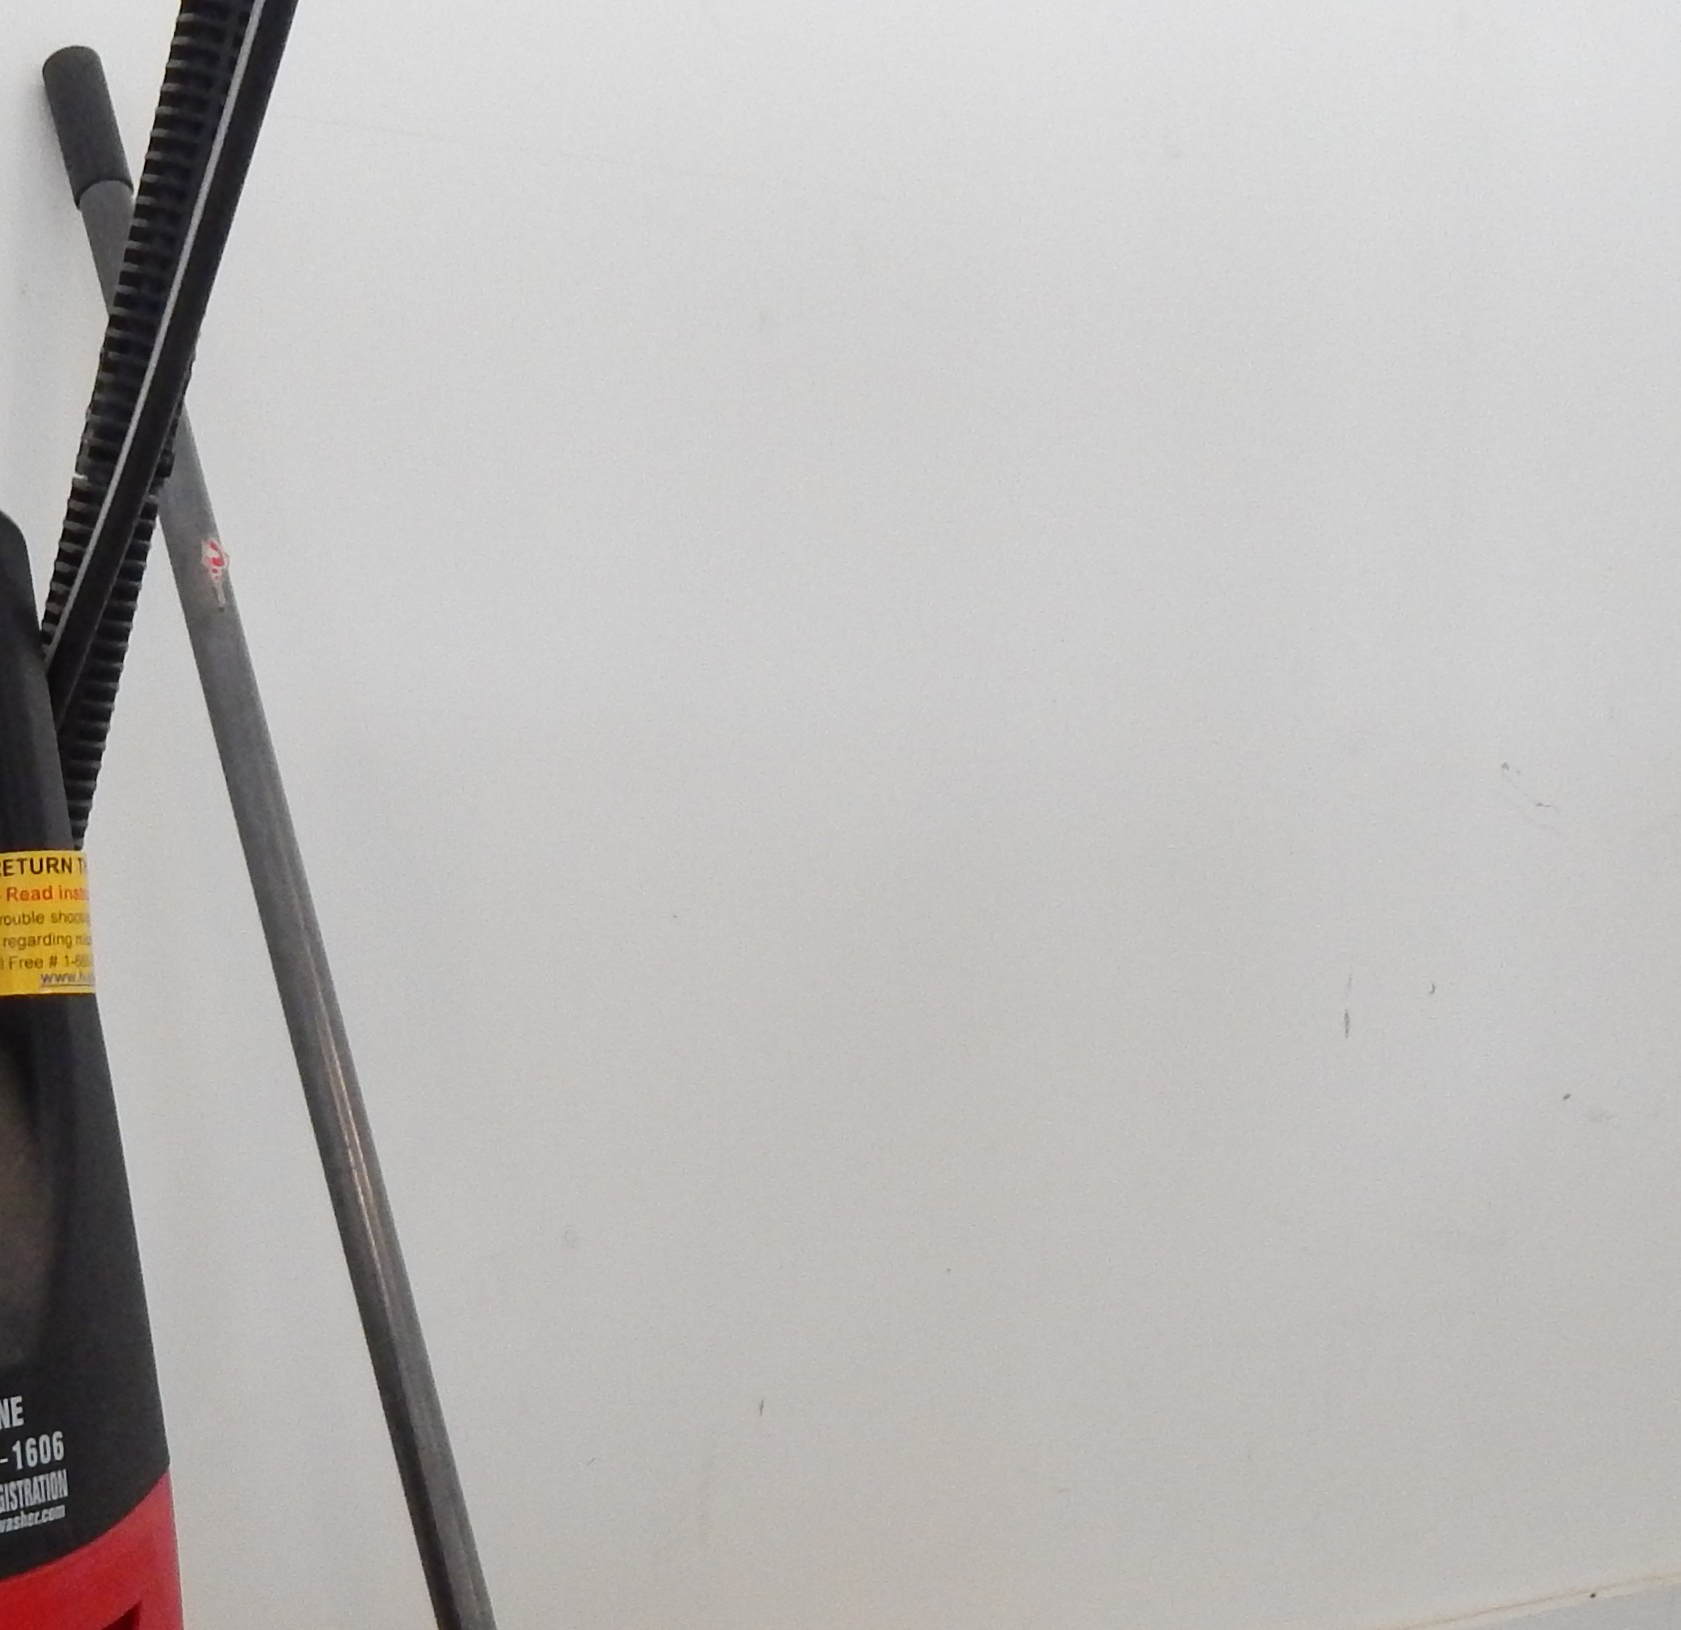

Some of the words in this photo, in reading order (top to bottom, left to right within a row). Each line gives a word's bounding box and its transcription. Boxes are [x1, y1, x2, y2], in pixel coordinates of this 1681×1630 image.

[7, 885, 53, 902] Read
[3, 932, 73, 950] regarding
[9, 955, 44, 970] Free
